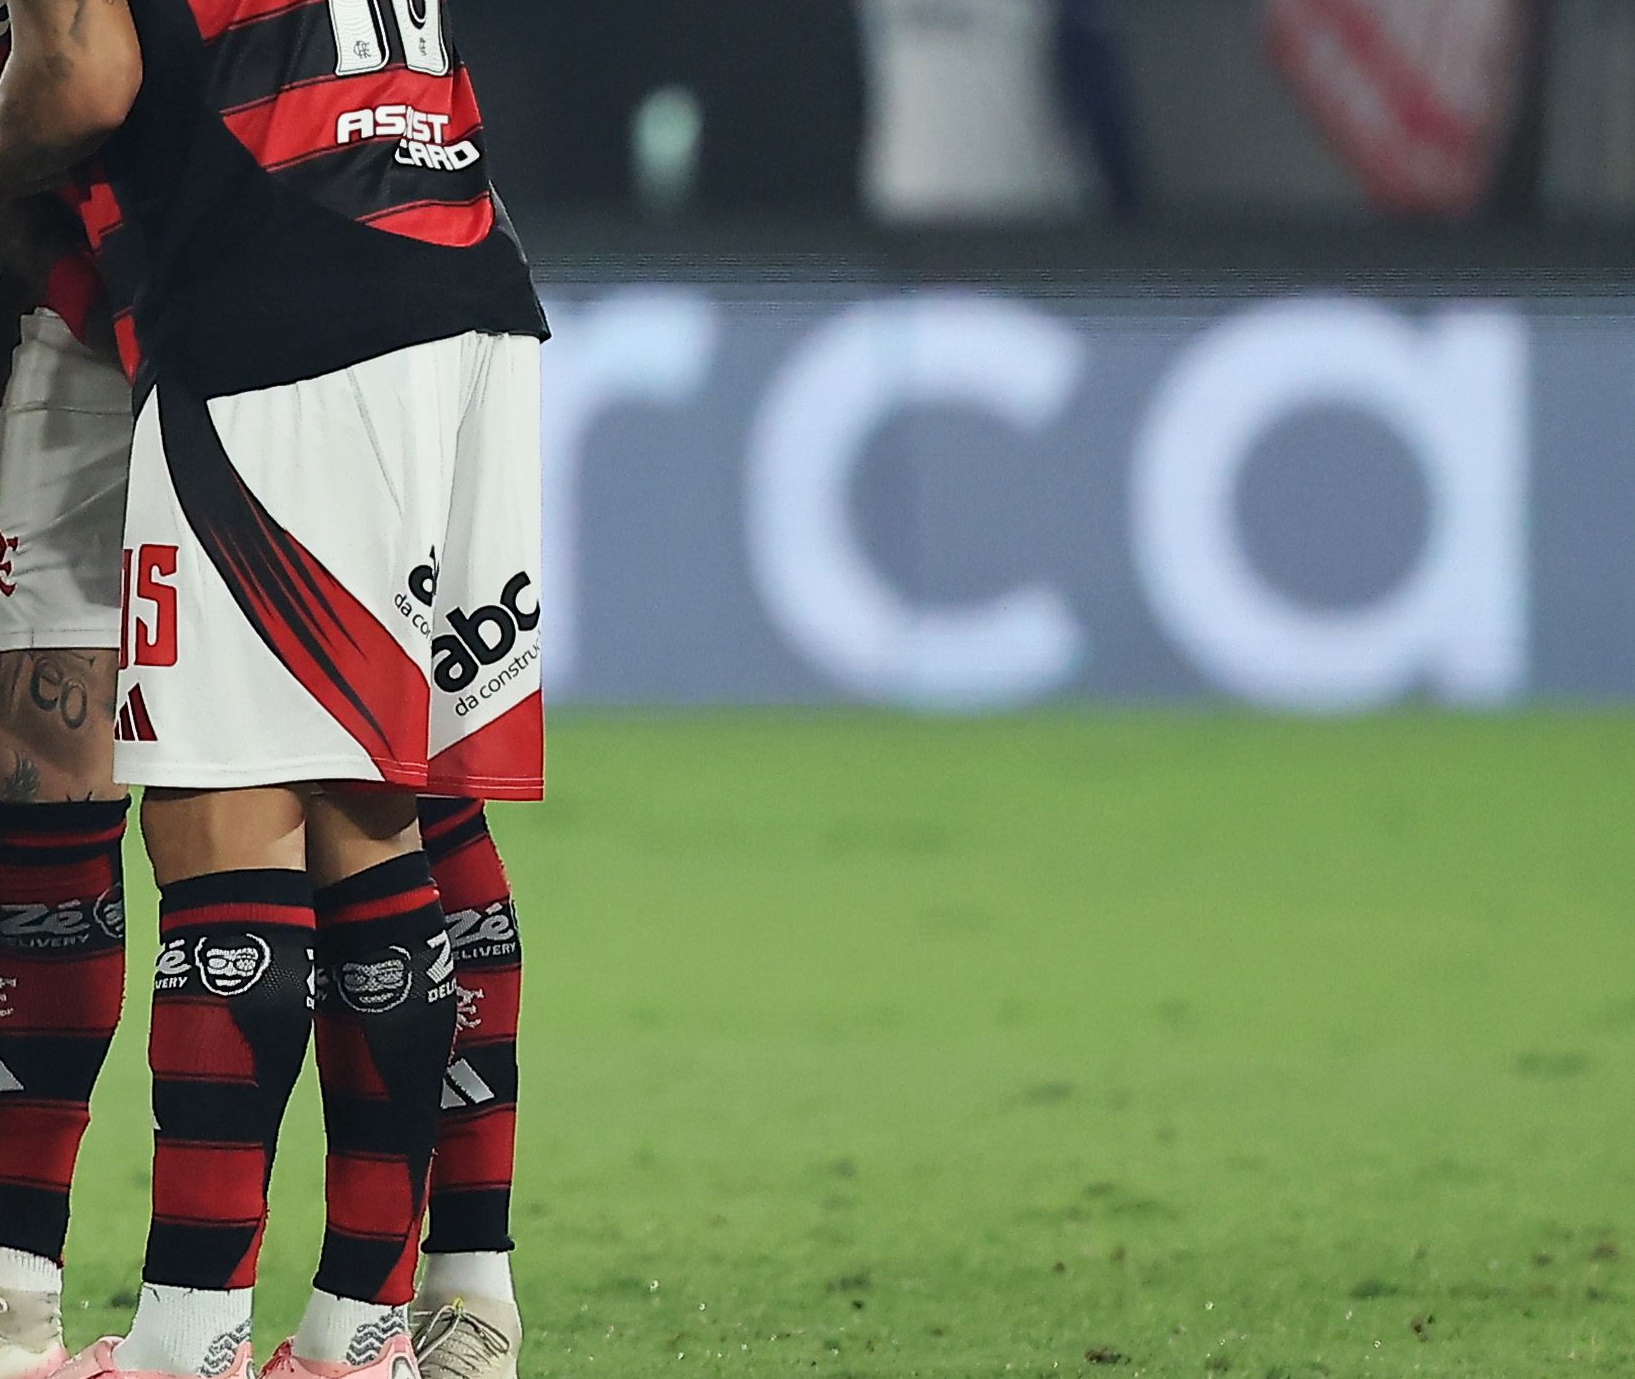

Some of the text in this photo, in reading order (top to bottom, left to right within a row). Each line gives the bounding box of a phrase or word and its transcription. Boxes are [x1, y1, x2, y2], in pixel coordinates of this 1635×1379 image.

[394, 138, 481, 171] CARD
[393, 592, 413, 618] da
[432, 570, 541, 693] abc
[454, 638, 541, 717] da constru
[155, 938, 193, 976] é
[425, 929, 454, 986] Z
[453, 941, 517, 962] ELIVERY
